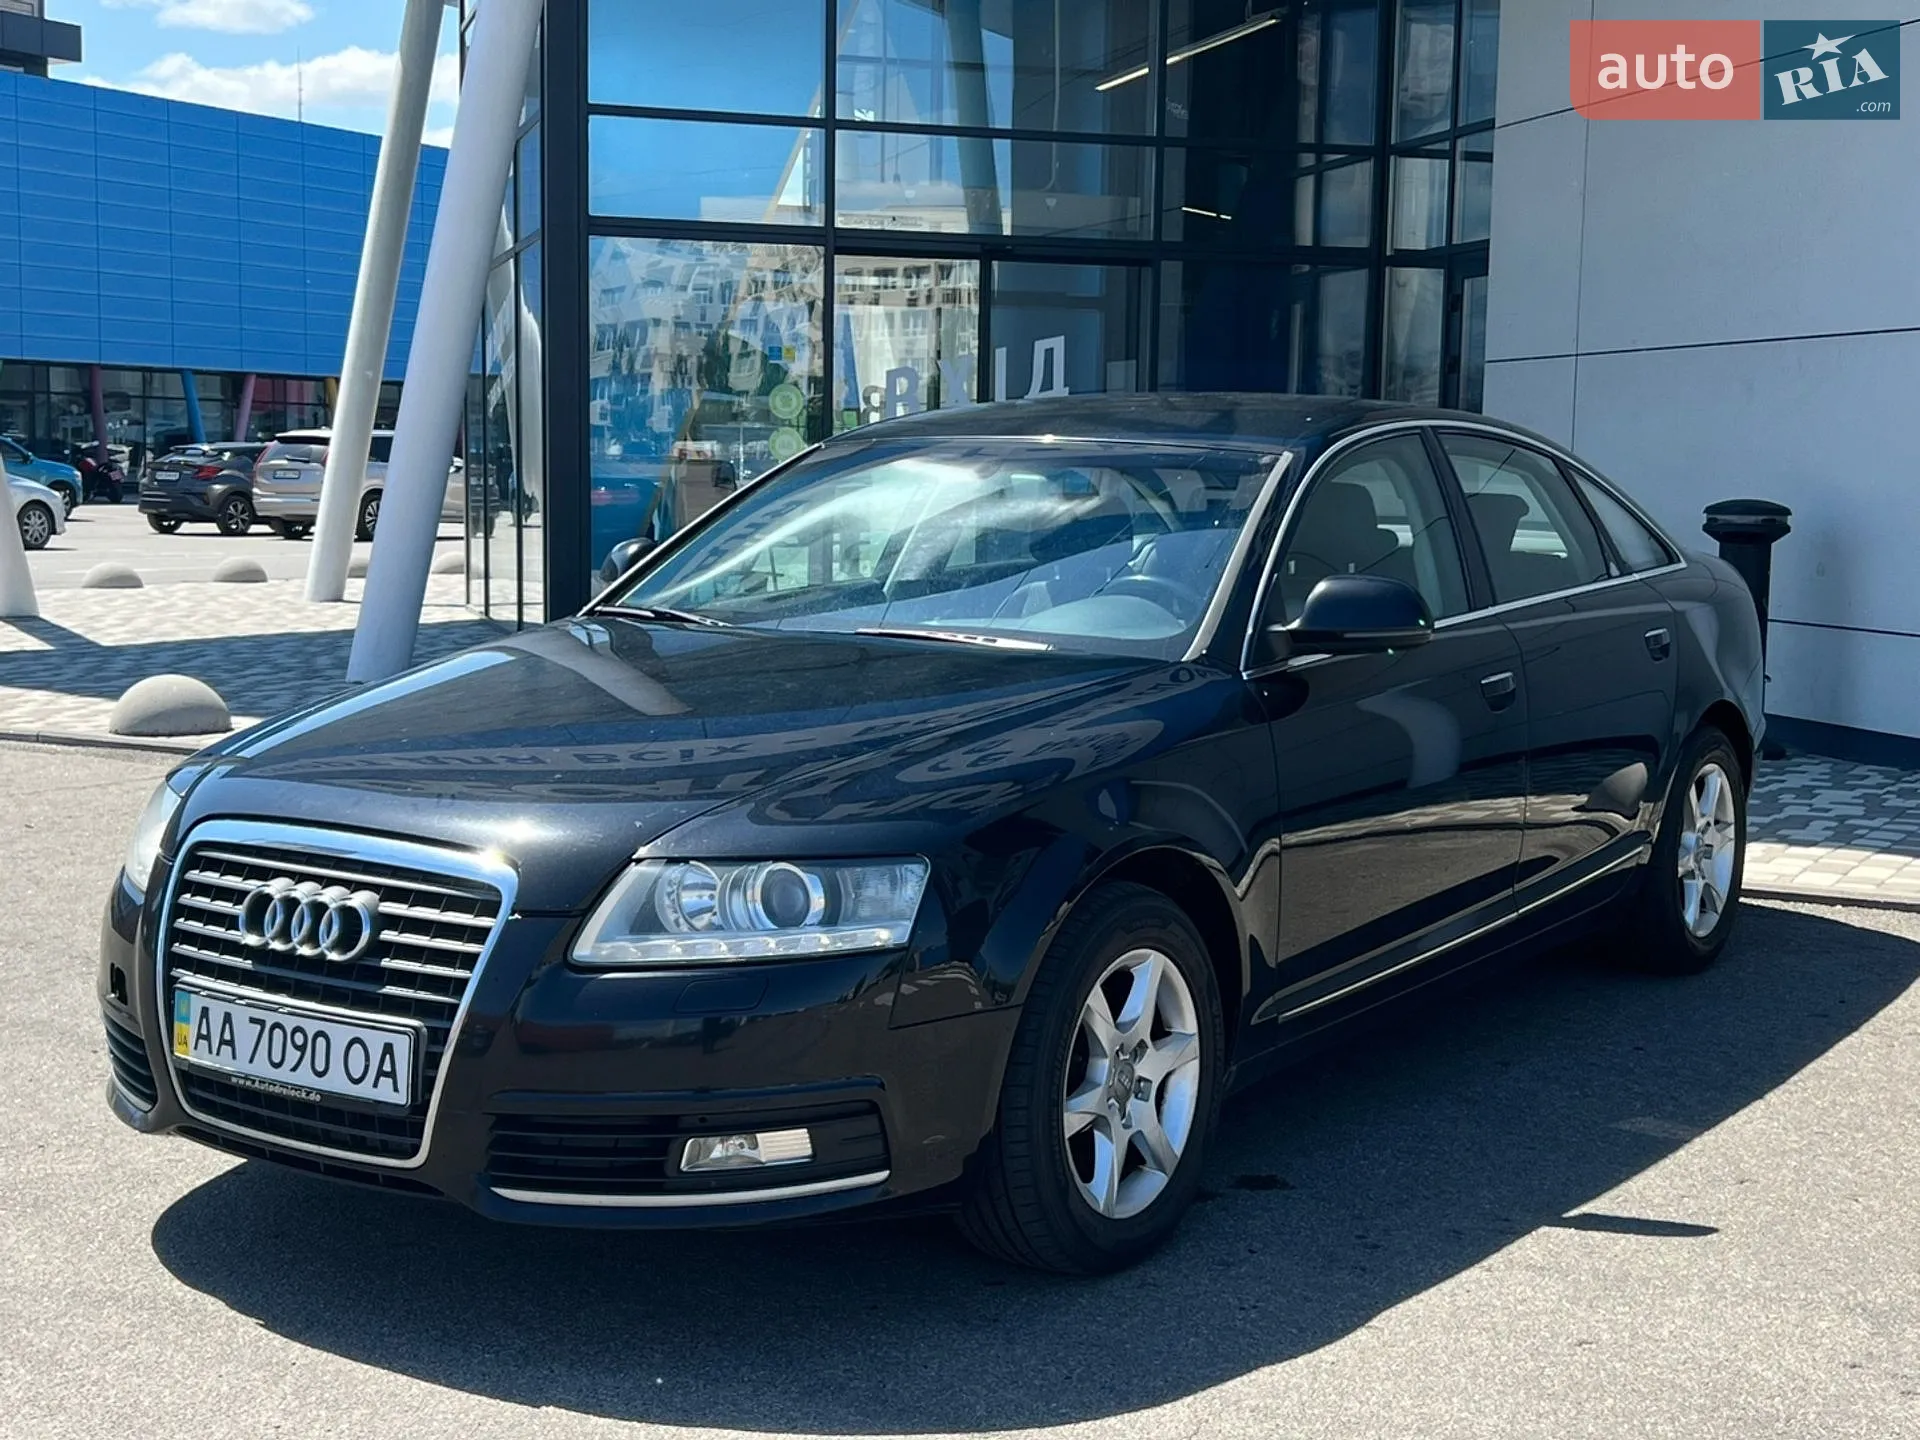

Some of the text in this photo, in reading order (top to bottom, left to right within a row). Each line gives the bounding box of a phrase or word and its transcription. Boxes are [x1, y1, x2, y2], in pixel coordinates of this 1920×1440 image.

[177, 1031, 188, 1048] UA
[194, 1005, 400, 1093] AA 7090 OA
